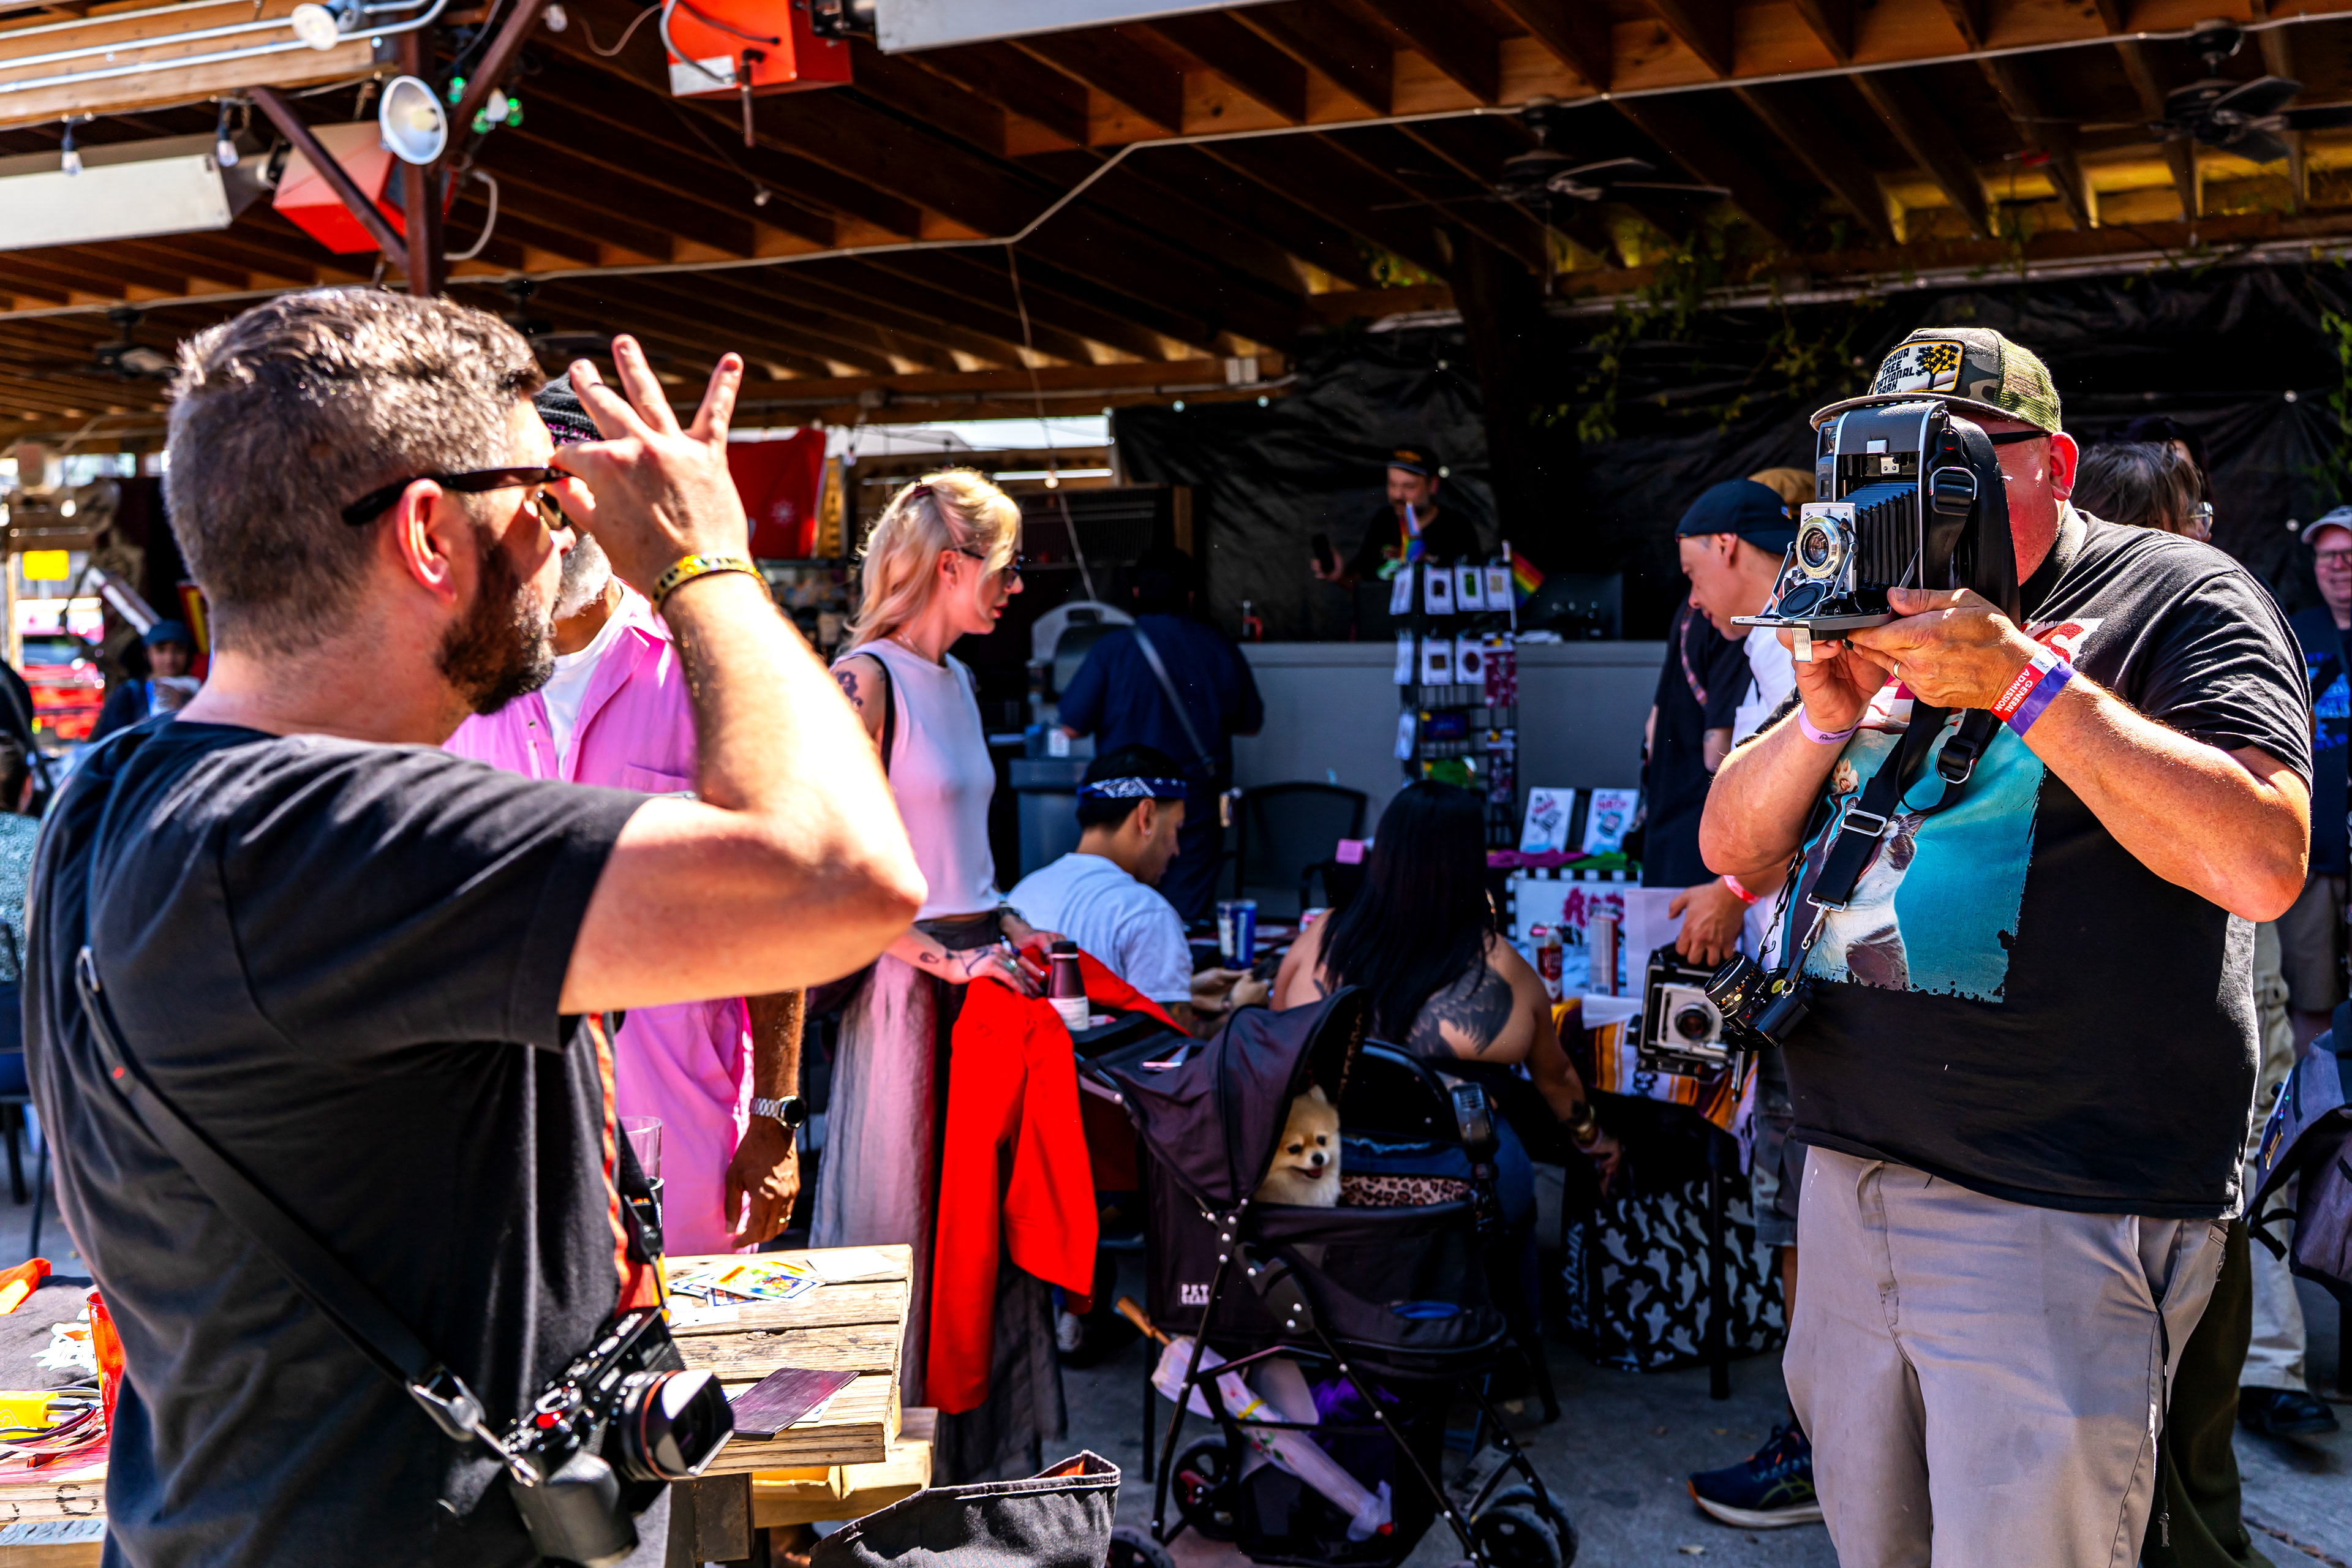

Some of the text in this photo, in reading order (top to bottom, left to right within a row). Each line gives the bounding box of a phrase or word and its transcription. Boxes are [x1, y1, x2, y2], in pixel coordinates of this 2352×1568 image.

[1882, 347, 1910, 368] JOSHUA
[1874, 366, 1915, 392] NATIONAL
[1882, 360, 1902, 378] TREE
[1877, 379, 1898, 394] PARK
[1994, 668, 2030, 712] ADMISSION
[2003, 680, 2033, 713] GENERAL
[1181, 1283, 1210, 1295] PET
